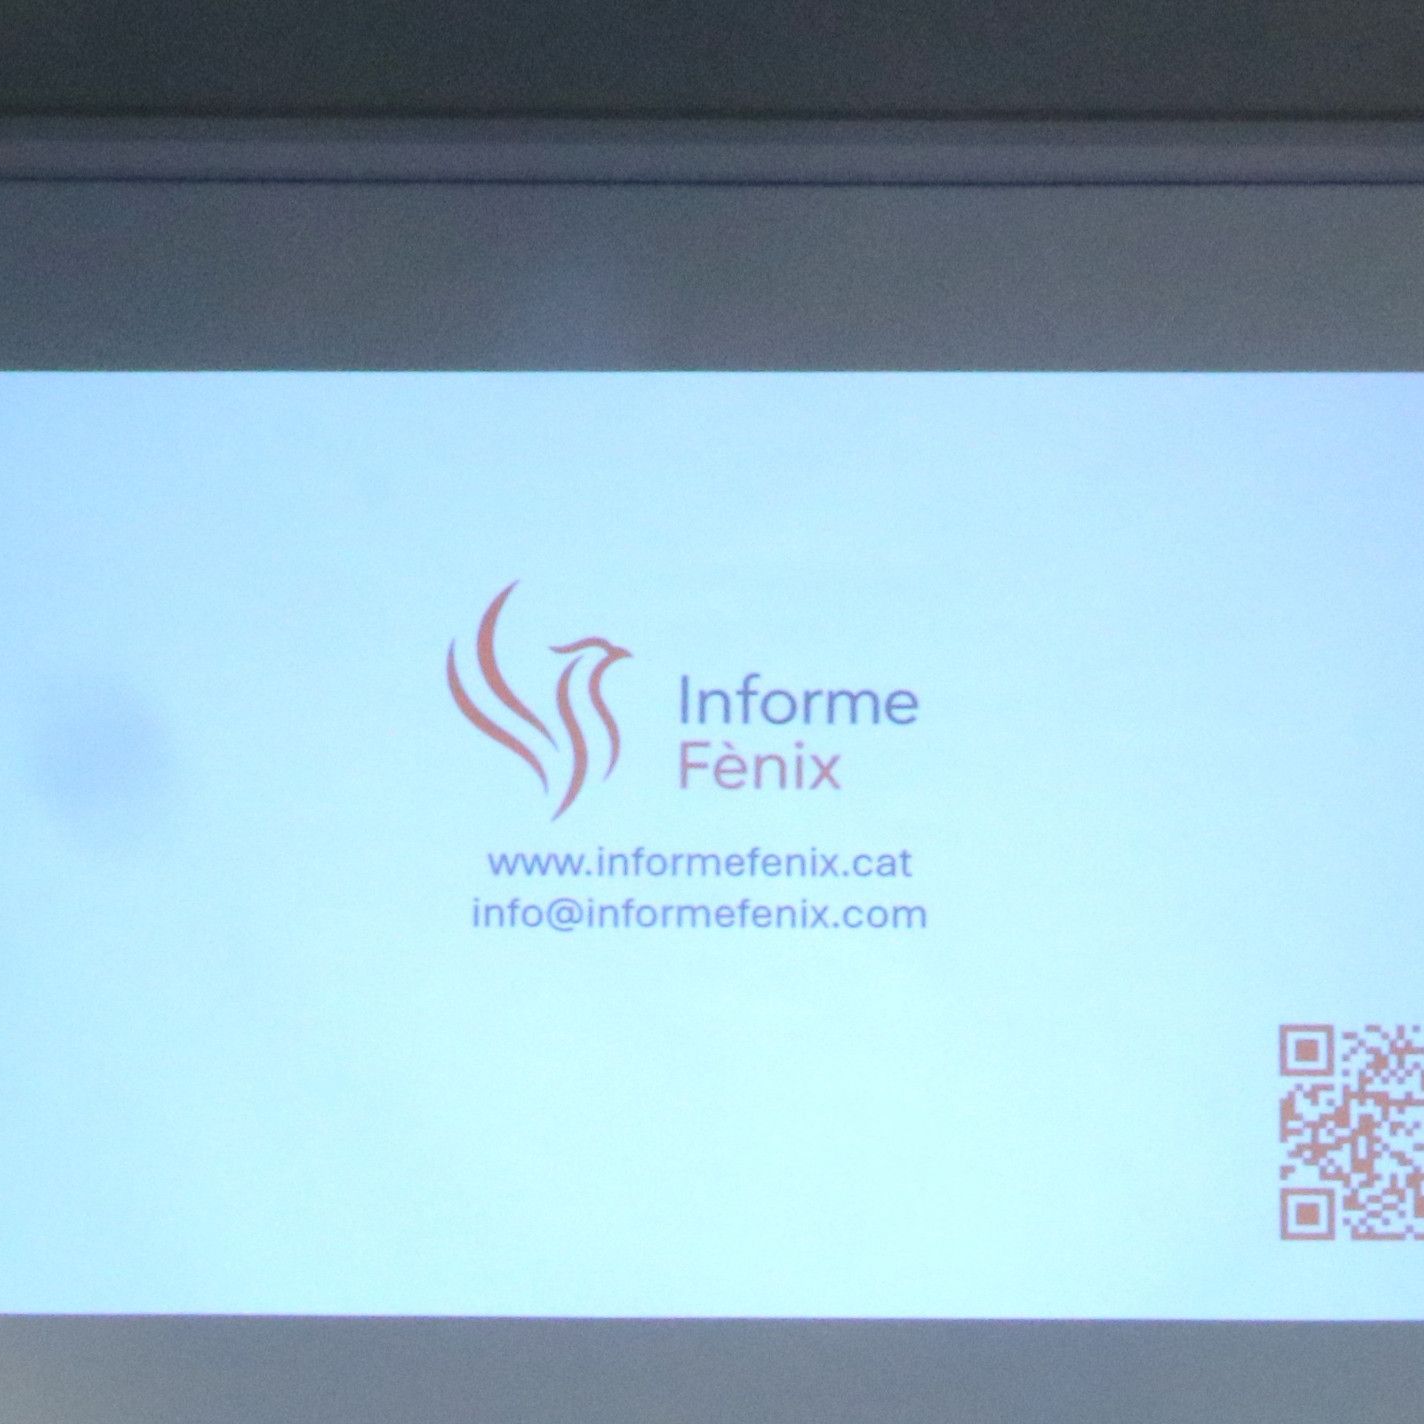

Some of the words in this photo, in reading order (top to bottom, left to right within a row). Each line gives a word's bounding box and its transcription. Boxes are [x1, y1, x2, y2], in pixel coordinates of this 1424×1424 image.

[679, 672, 920, 726] Informe
[678, 740, 842, 791] Fènix
[487, 845, 913, 879] www.informefenix.cat
[472, 896, 927, 933] info@informefenix.com
